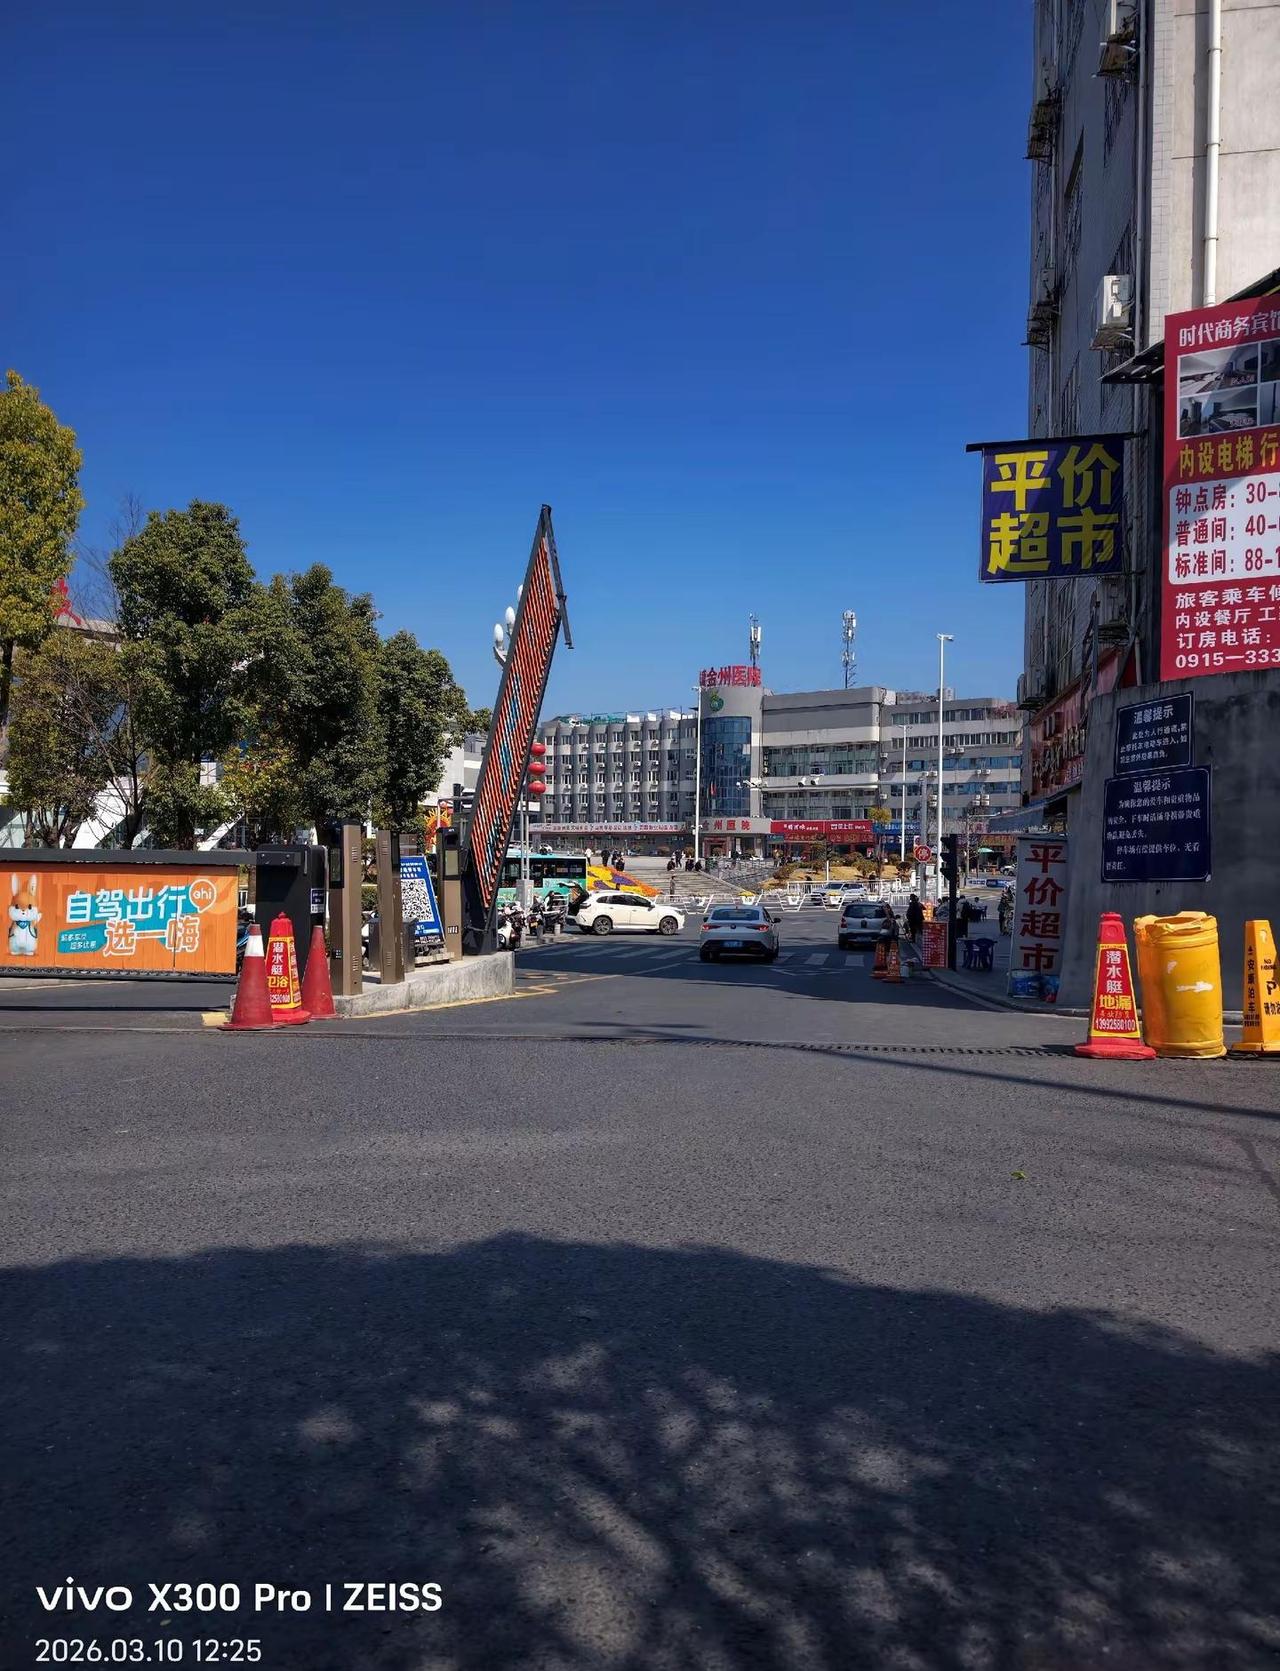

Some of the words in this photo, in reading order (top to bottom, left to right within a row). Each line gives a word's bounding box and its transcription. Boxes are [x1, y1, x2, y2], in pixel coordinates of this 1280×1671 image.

[1179, 436, 1255, 478] 内设电梯
[1260, 432, 1280, 467] 行
[990, 443, 1121, 511] 平价
[1175, 484, 1236, 514] 钟点房：
[1246, 481, 1280, 504] 30-
[987, 509, 1119, 575] 超市
[1175, 517, 1235, 547] 普通间：
[1245, 514, 1280, 536] 40-
[1175, 549, 1235, 578] 标准间：
[1175, 608, 1252, 629] 内设餐厅
[1258, 606, 1280, 621] 工
[1176, 627, 1271, 649] 订房电话：
[1134, 705, 1174, 725] 温馨提示
[1133, 778, 1171, 794] 温馨提示
[66, 885, 187, 924] 自驾出行
[1019, 843, 1067, 971] 平价超市
[102, 914, 200, 957] 选一嗨
[272, 942, 284, 975] 潜水艇
[1106, 951, 1123, 993] 潜水艇
[267, 975, 288, 988] 卫浴
[1099, 995, 1132, 1011] 地漏
